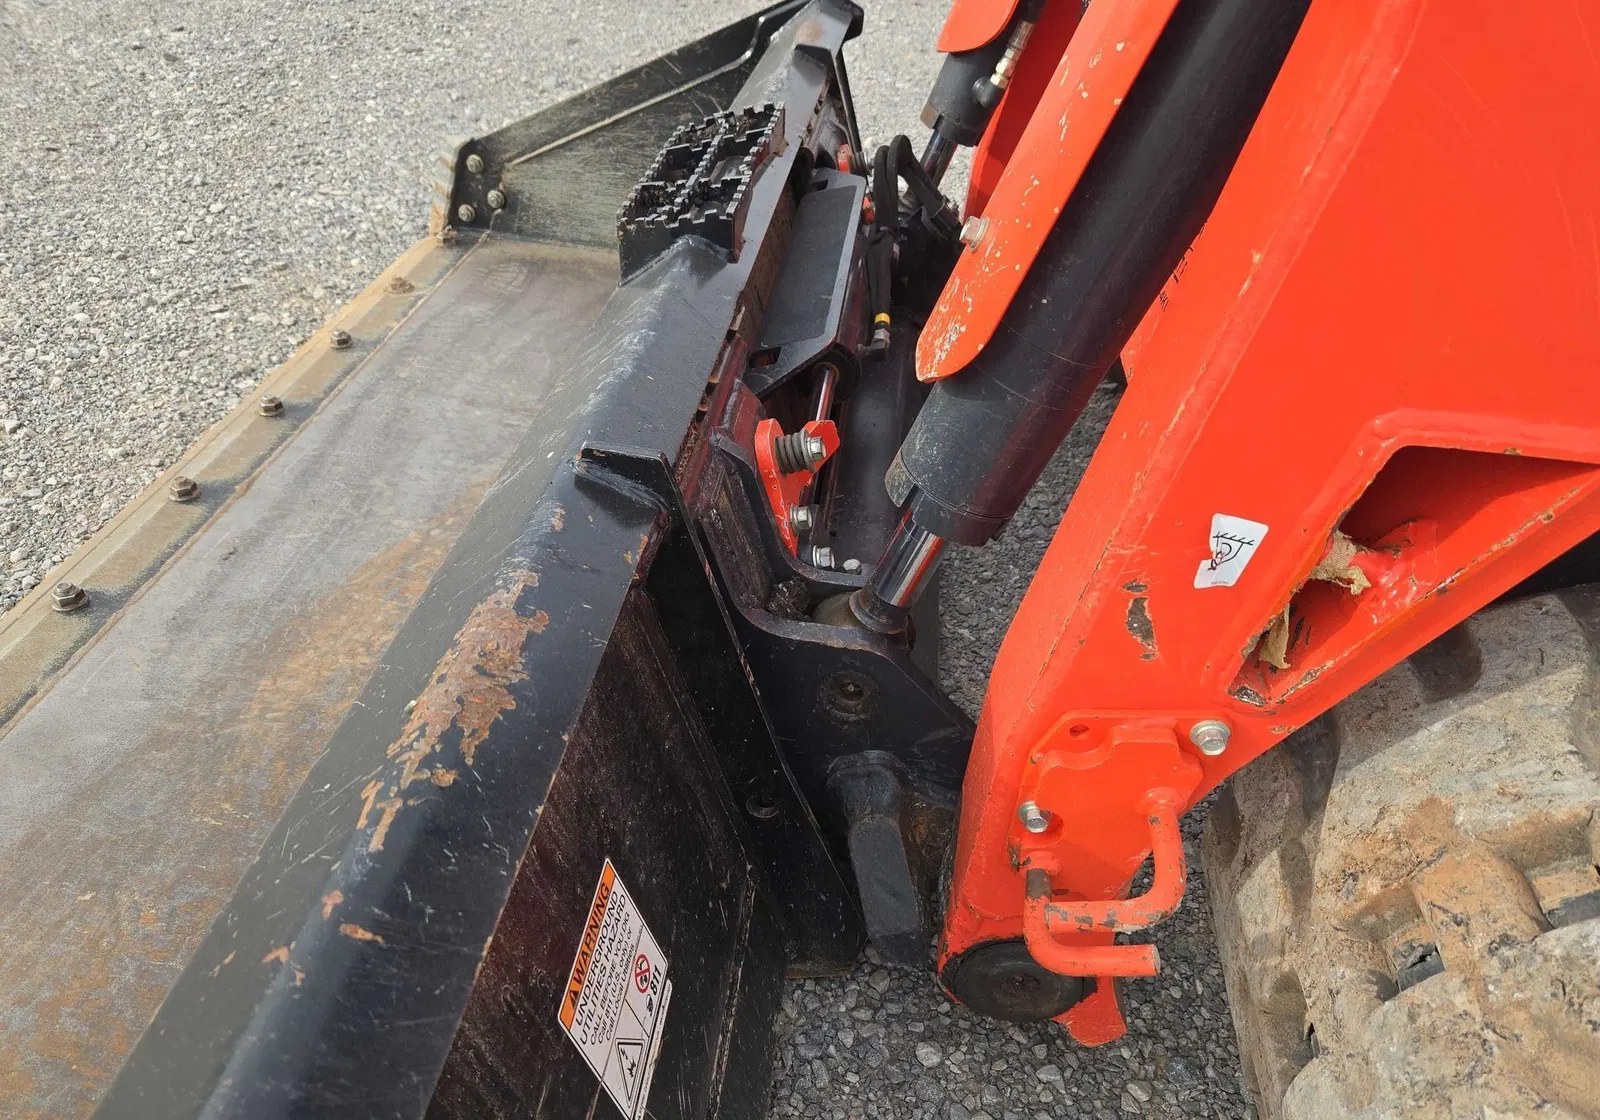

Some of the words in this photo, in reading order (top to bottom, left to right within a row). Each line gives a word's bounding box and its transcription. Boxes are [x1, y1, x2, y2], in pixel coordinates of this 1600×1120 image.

[573, 883, 609, 984] WARNING
[576, 891, 618, 1025] UNDERGROUND
[580, 963, 606, 1045] UTILITIES
[604, 894, 626, 962] HAZARD
[591, 1014, 603, 1045] CALL
[600, 960, 616, 1010] BEFORE
[613, 933, 623, 957] YOU
[621, 912, 630, 933] DIG
[598, 1019, 607, 1044] Call
[611, 971, 621, 998] (U.S.
[620, 940, 629, 968] only)
[627, 926, 632, 939] or
[606, 1017, 615, 1041] Call
[613, 983, 623, 1017] Local
[621, 944, 634, 982] Utilities
[650, 964, 661, 995] 811
